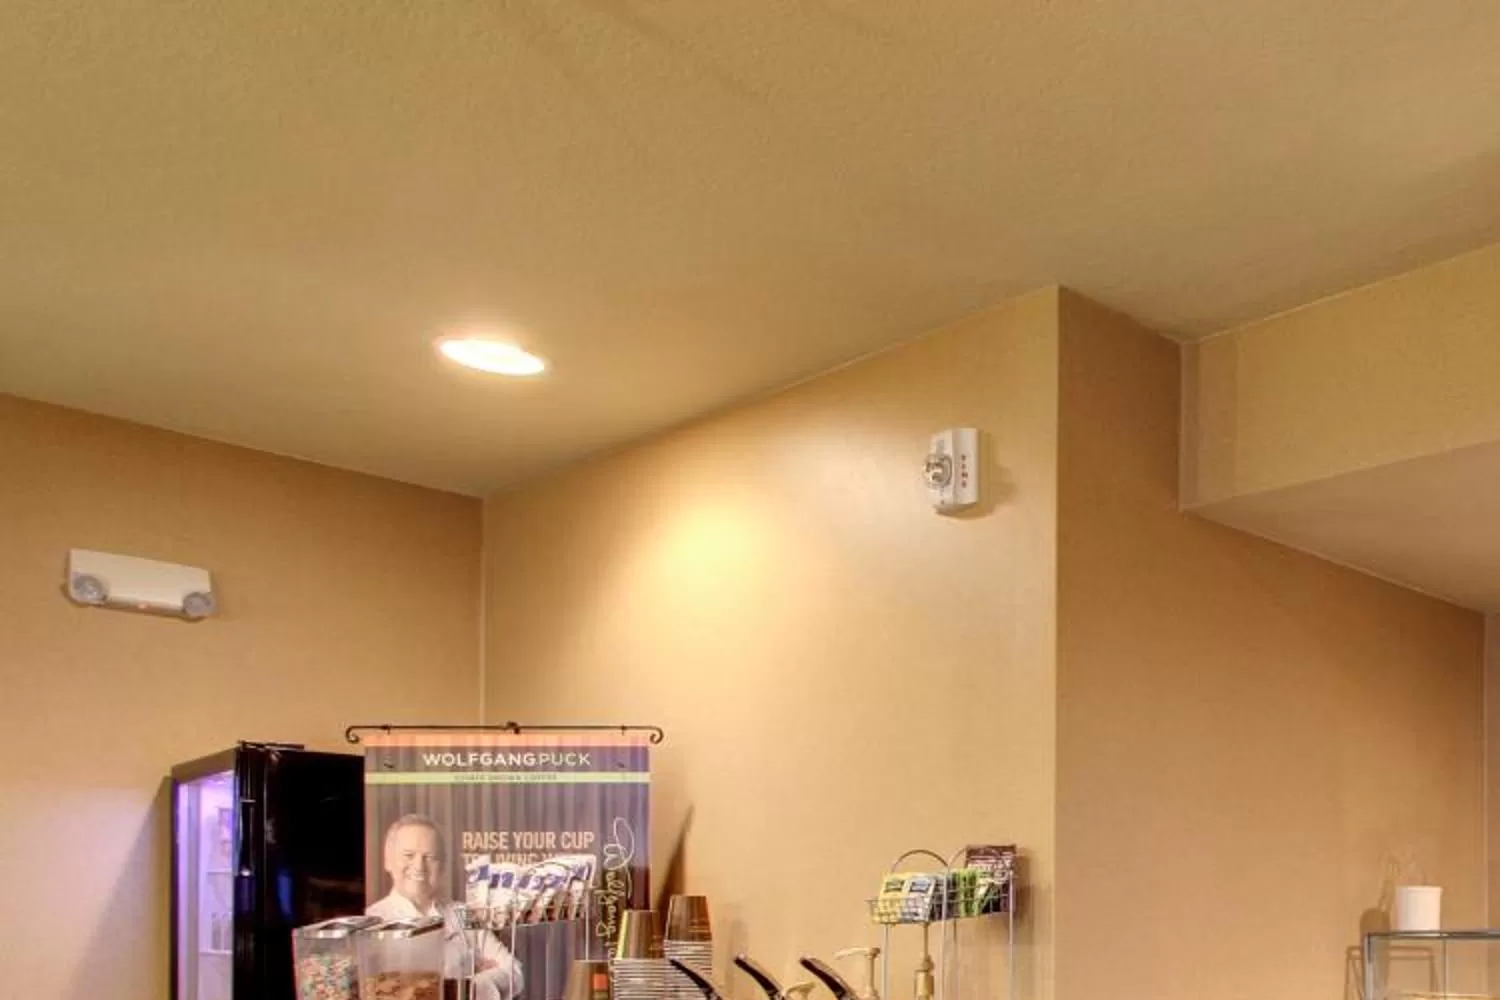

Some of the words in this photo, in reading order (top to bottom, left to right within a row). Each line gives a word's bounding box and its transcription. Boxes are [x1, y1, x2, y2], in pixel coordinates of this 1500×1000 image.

[462, 832, 510, 849] RAISE
[513, 832, 556, 849] YOUR
[561, 832, 596, 849] CUP
